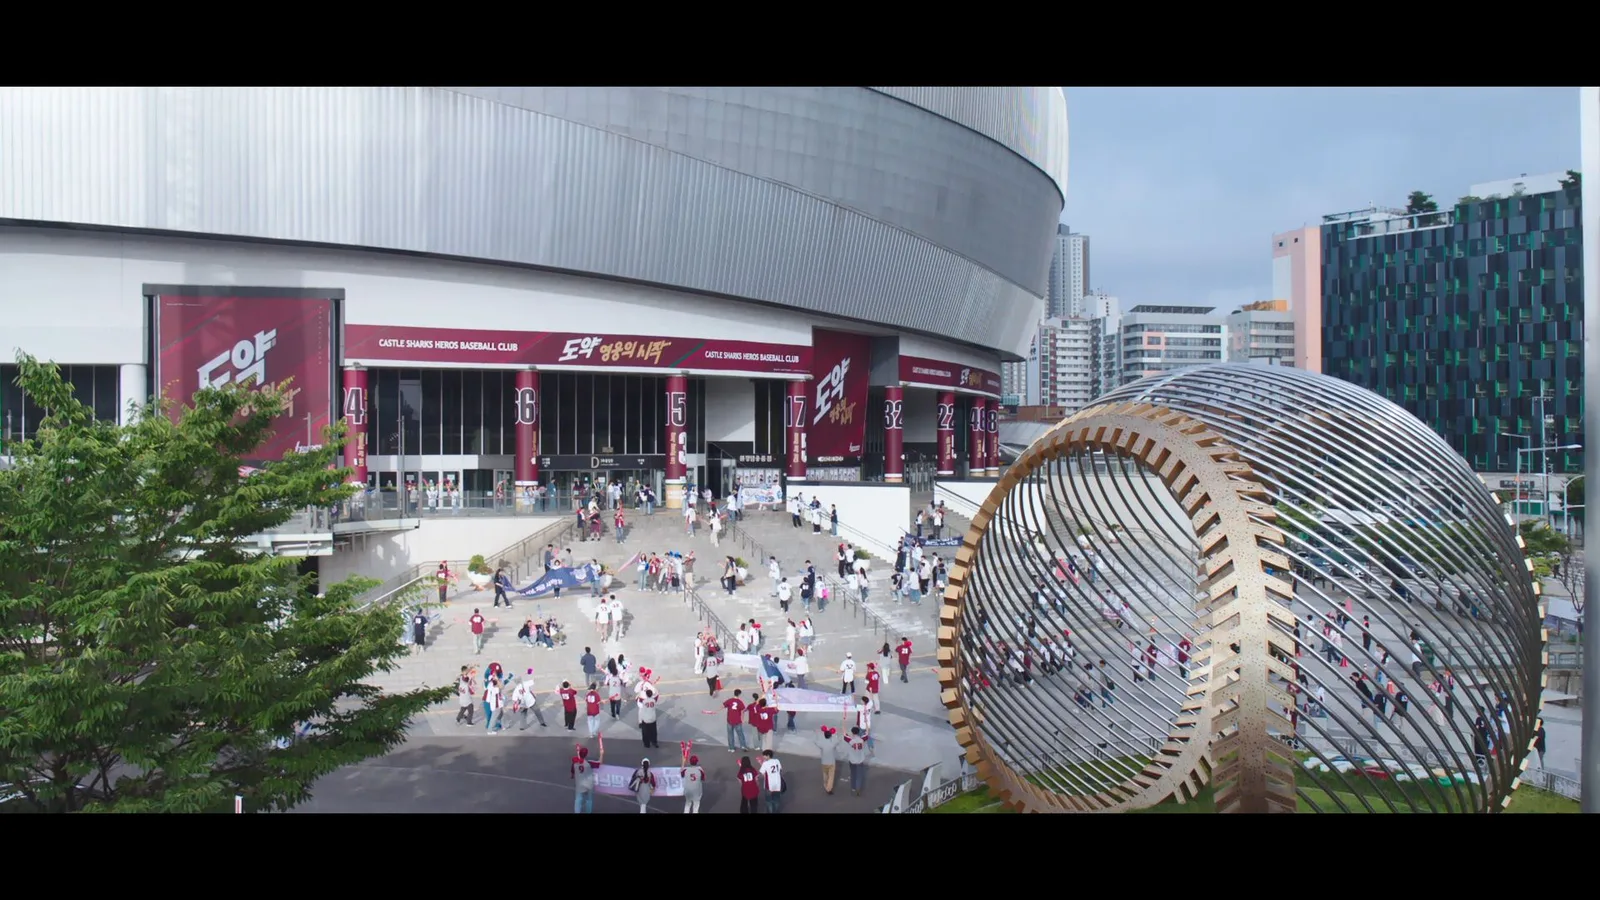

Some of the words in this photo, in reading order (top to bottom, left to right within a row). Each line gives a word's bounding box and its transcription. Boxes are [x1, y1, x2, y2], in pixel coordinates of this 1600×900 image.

[378, 339, 405, 348] CASTLE
[406, 339, 434, 349] SHARKS
[434, 340, 459, 350] HEROS
[460, 341, 497, 351] BASEBALL
[497, 342, 518, 352] CLUB
[558, 336, 602, 362] 도약
[600, 341, 638, 362] 영웅의
[636, 340, 672, 365] 시작
[705, 350, 723, 359] CASTLE
[723, 351, 742, 360] SHARKS
[743, 352, 760, 361] HEROS
[760, 353, 785, 363] BASEBALL
[785, 354, 800, 363] CLUB
[813, 356, 851, 426] 도약
[884, 399, 903, 431] 32
[937, 403, 955, 431] 22
[590, 456, 600, 469] D
[731, 702, 737, 710] 2
[771, 764, 780, 773] 21
[690, 773, 697, 782] 5
[743, 772, 753, 782] 10
